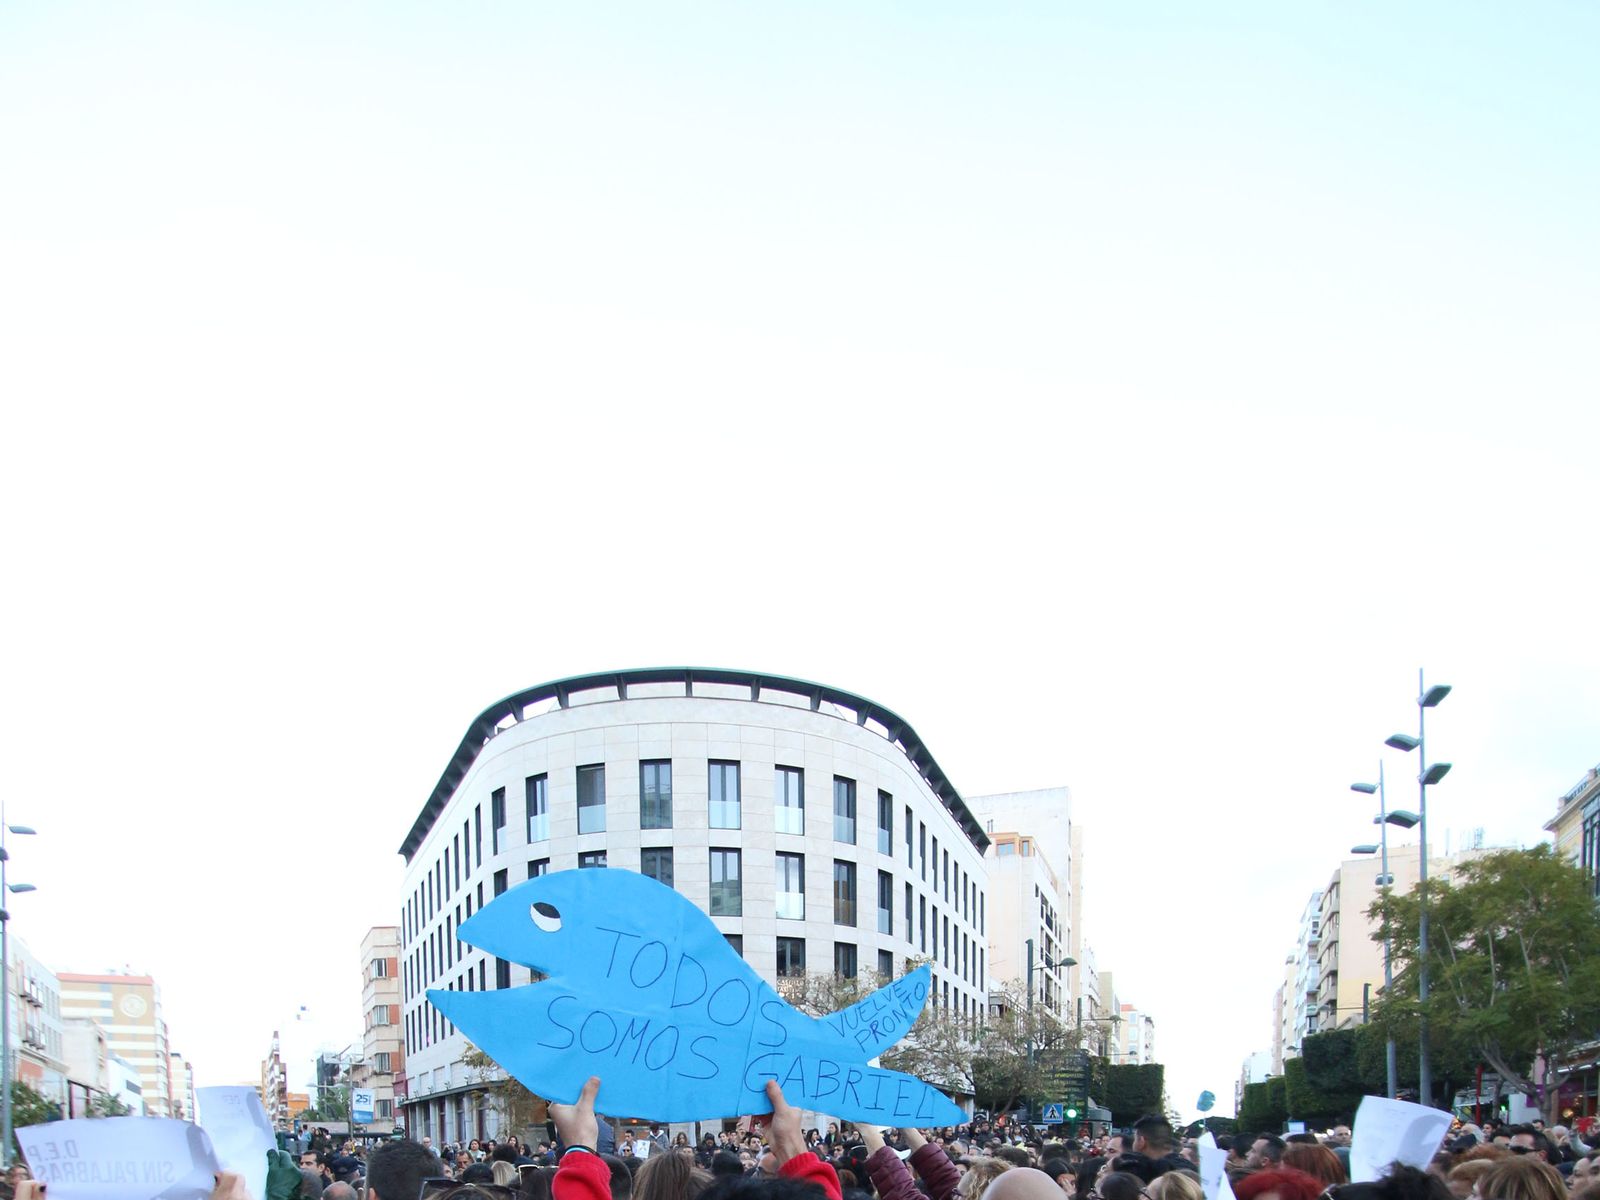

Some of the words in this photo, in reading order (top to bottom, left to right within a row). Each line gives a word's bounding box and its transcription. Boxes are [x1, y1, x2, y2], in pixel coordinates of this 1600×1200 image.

[596, 927, 787, 1047] TODOS
[827, 979, 907, 1038] VUELVE
[854, 982, 926, 1053] PRONTO
[537, 996, 720, 1080] SOMOS
[745, 1053, 935, 1120] GABRIEL
